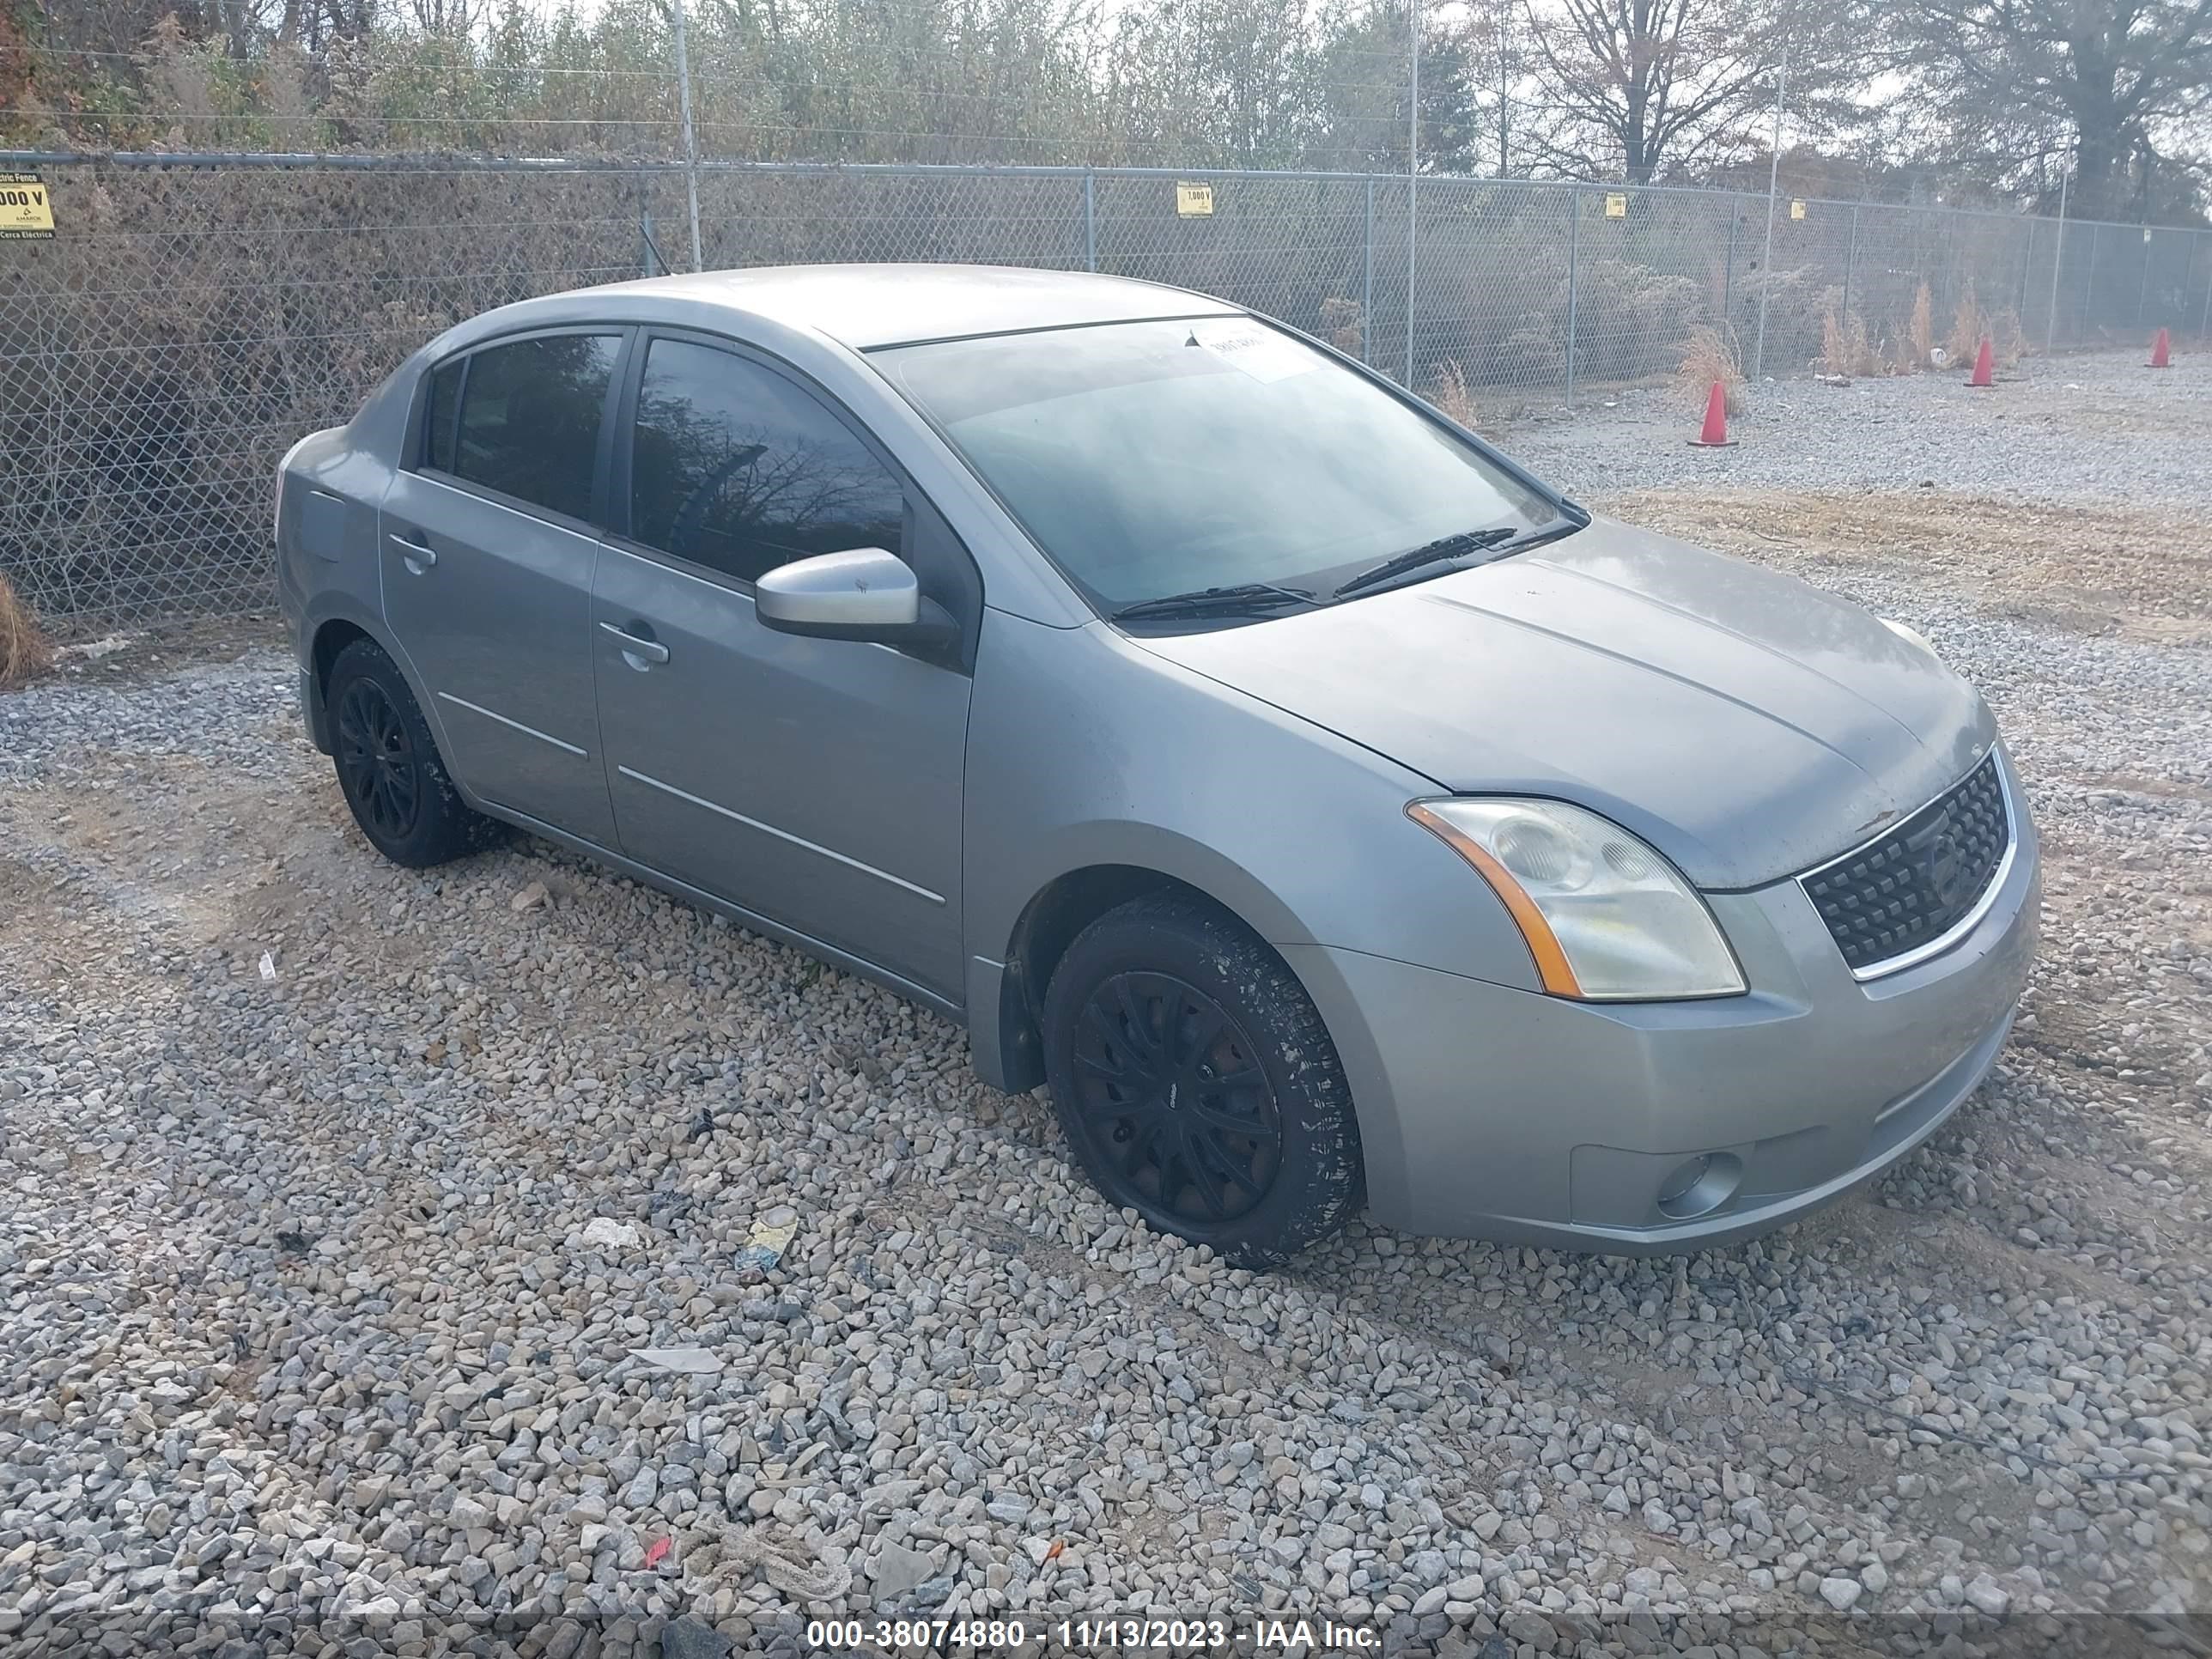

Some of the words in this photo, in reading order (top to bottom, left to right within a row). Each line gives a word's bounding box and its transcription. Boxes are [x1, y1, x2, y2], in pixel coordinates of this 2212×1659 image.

[15, 173, 38, 182] Fence
[32, 191, 43, 206] V
[1188, 191, 1205, 201] 1,000
[1206, 191, 1210, 200] V
